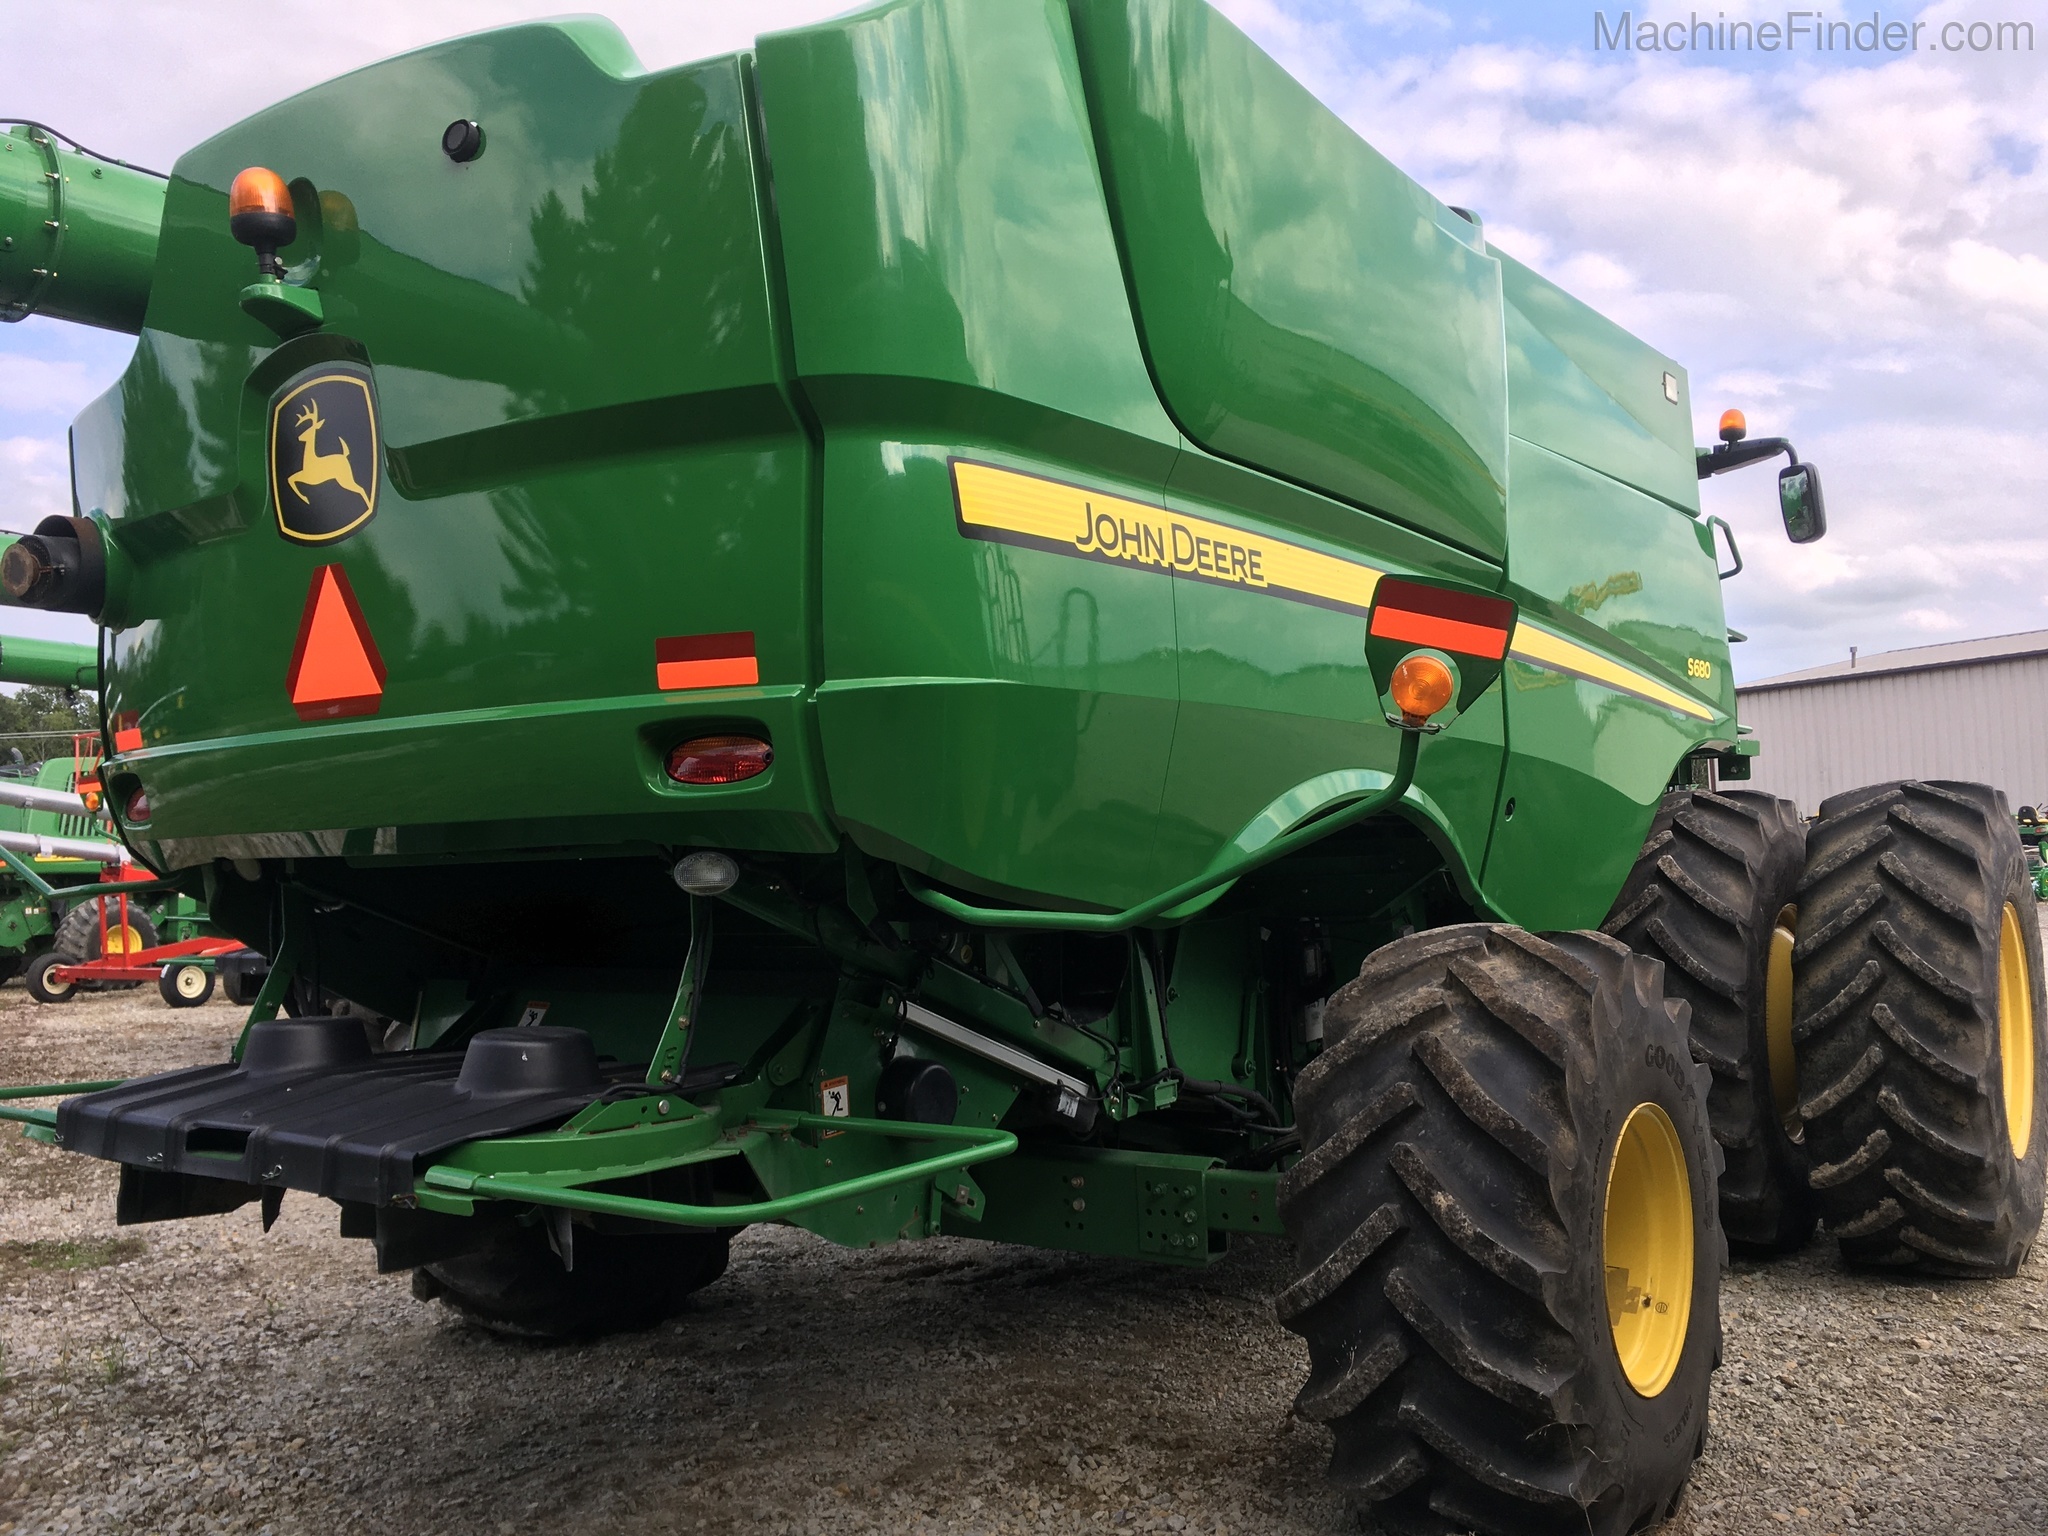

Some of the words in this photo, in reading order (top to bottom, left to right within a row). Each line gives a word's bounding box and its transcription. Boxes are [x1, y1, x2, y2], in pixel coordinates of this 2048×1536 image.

[1076, 502, 1165, 562] JOHN
[1171, 522, 1265, 582] DEERE
[1687, 657, 1711, 679] S680
